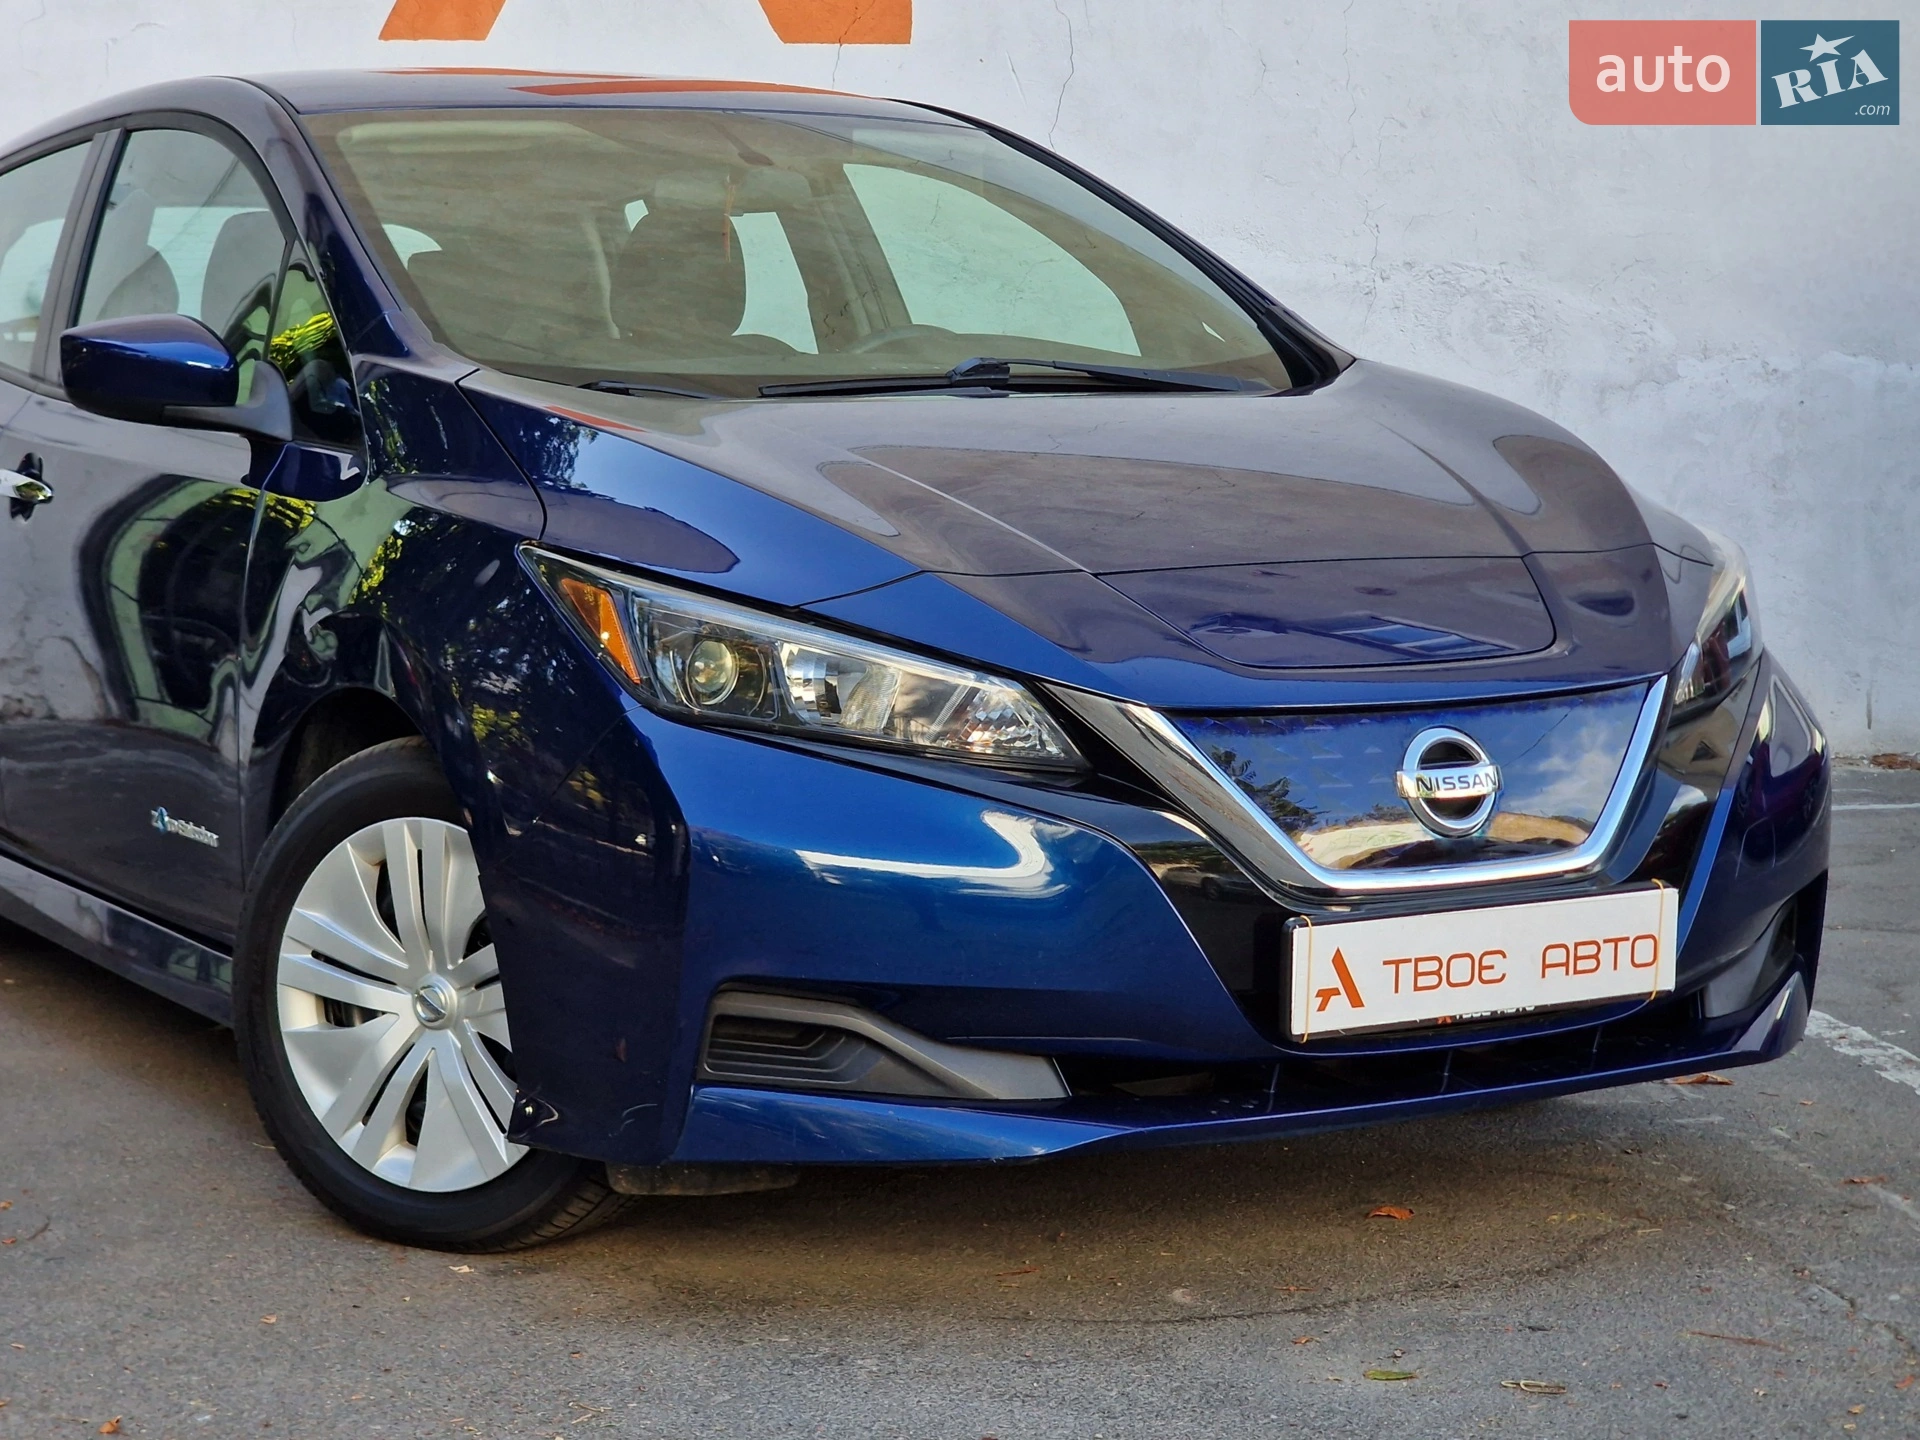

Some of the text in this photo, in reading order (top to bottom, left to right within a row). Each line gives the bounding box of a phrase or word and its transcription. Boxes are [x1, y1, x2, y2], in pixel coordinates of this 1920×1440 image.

[1415, 771, 1497, 792] NISSAN
[1382, 949, 1507, 995] ТВОЄ
[1541, 933, 1658, 979] АВТО
